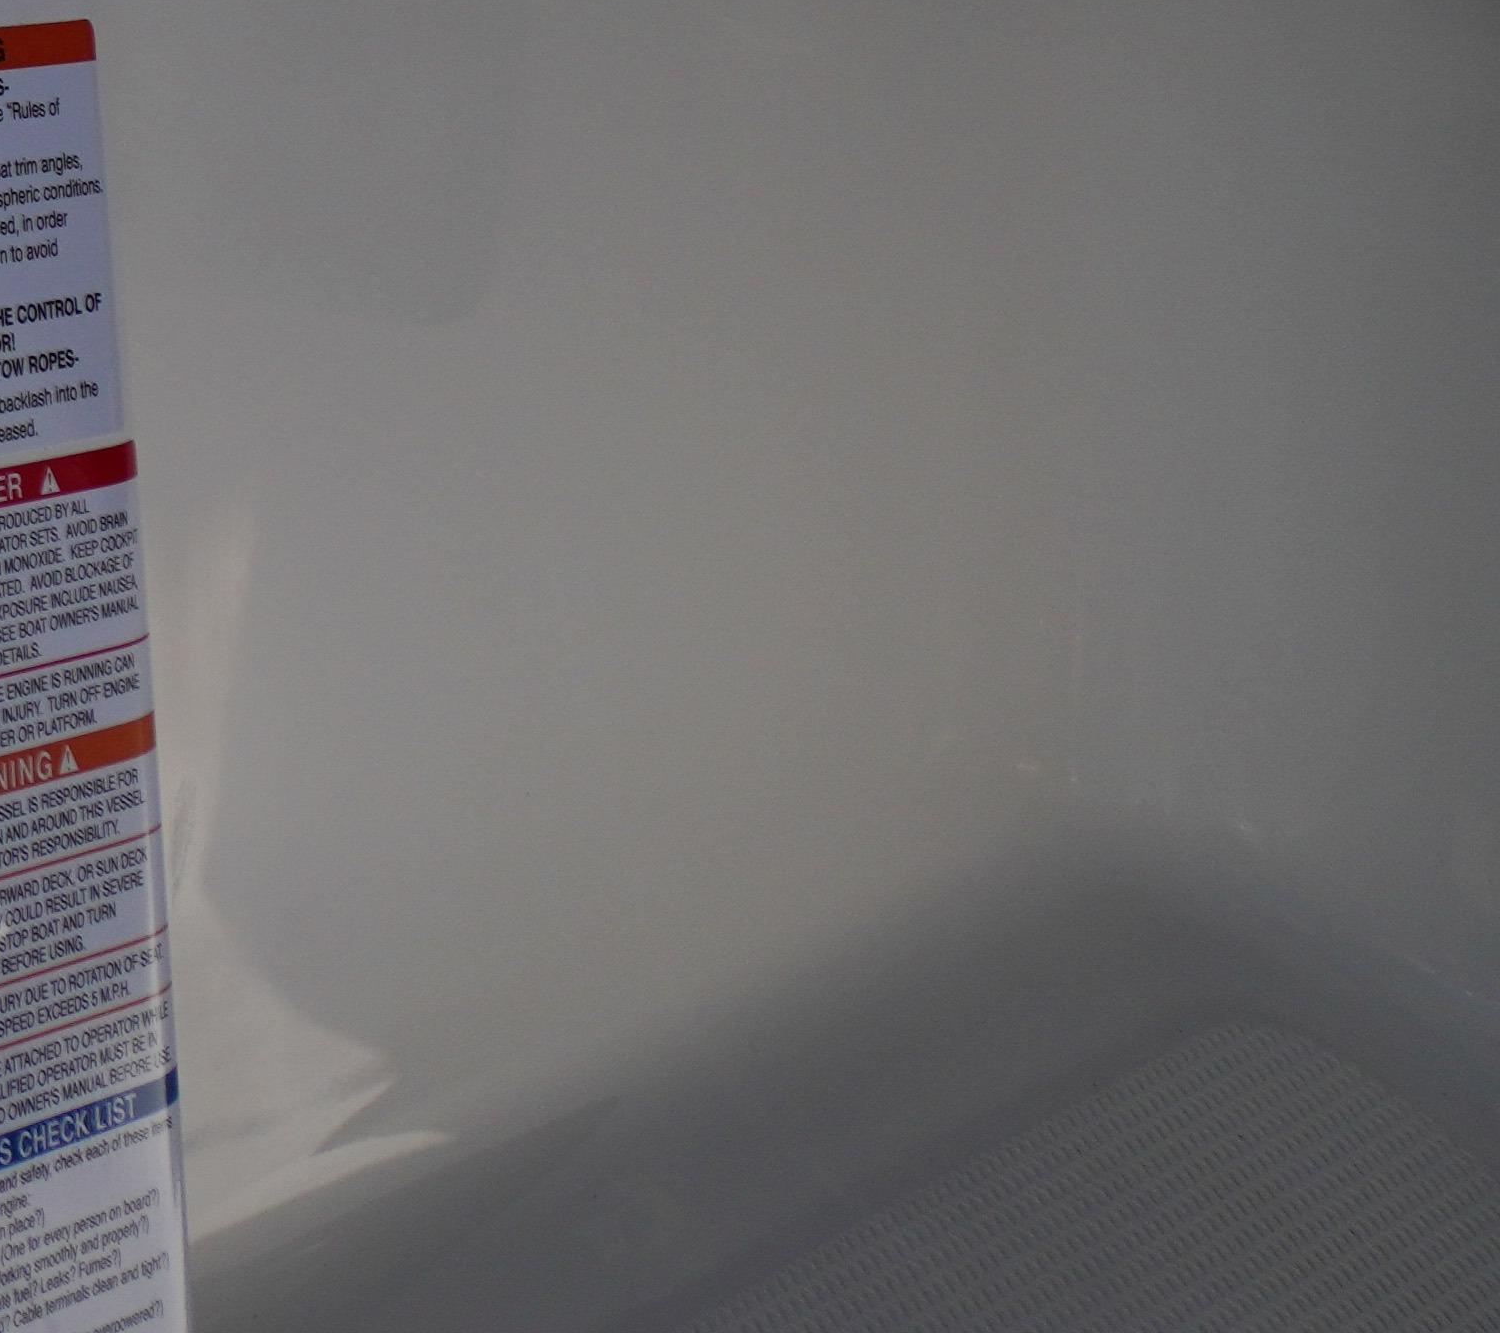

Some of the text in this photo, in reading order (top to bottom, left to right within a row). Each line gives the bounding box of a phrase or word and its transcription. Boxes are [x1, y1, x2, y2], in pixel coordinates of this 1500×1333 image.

[48, 97, 60, 116] of
[14, 158, 38, 176] trim
[40, 153, 82, 176] angles,
[22, 214, 34, 232] in
[36, 211, 68, 231] order
[10, 246, 23, 263] to
[26, 238, 58, 261] avoid
[17, 297, 82, 324] CONTROL
[85, 292, 101, 313] OF
[28, 349, 79, 374] ROPES-
[55, 385, 78, 403] into
[80, 381, 98, 399] the
[54, 503, 69, 519] BY
[71, 499, 90, 516] ALL
[66, 518, 98, 539] AVOID
[99, 511, 128, 531] BRAIN
[70, 539, 99, 560] KEEP
[30, 570, 62, 591] AVOID
[64, 556, 121, 583] BLOCKAGE
[121, 552, 134, 569] OF
[50, 584, 97, 608] INCLUDE
[18, 617, 47, 639] BOAT
[18, 1113, 90, 1159] CHECK
[94, 1093, 137, 1129] LIST
